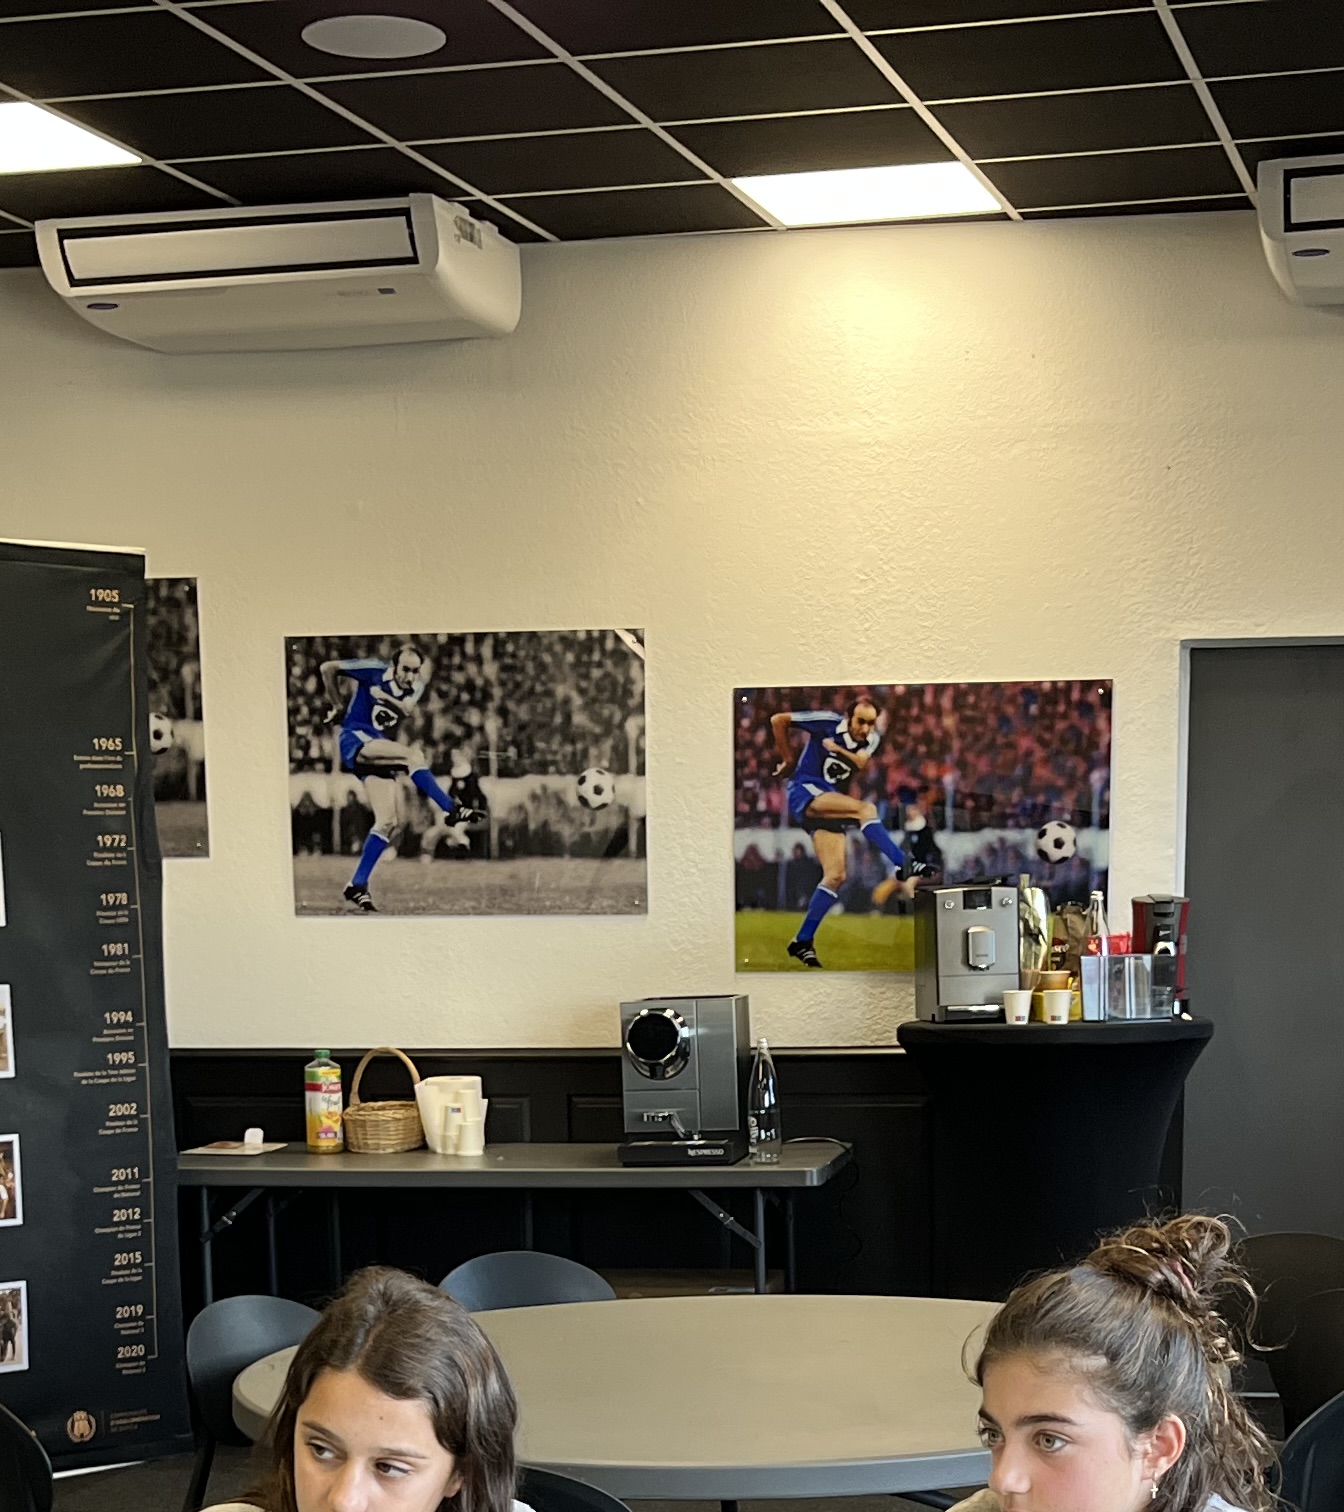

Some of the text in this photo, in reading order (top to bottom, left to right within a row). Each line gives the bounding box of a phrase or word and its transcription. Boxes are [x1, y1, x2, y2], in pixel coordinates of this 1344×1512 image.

[90, 588, 120, 602] 1905
[93, 738, 123, 751] 1965
[94, 784, 125, 798] 1968
[96, 834, 127, 848] 1972
[100, 893, 128, 906] 1978
[101, 943, 130, 957] 1981
[103, 1010, 133, 1024] 1994
[106, 1051, 136, 1066] 1995
[108, 1103, 138, 1117] 2002
[111, 1167, 140, 1182] 2011
[112, 1207, 142, 1222] 2012
[114, 1251, 143, 1267] 2015
[115, 1304, 145, 1319] 2019
[117, 1345, 146, 1360] 2020
